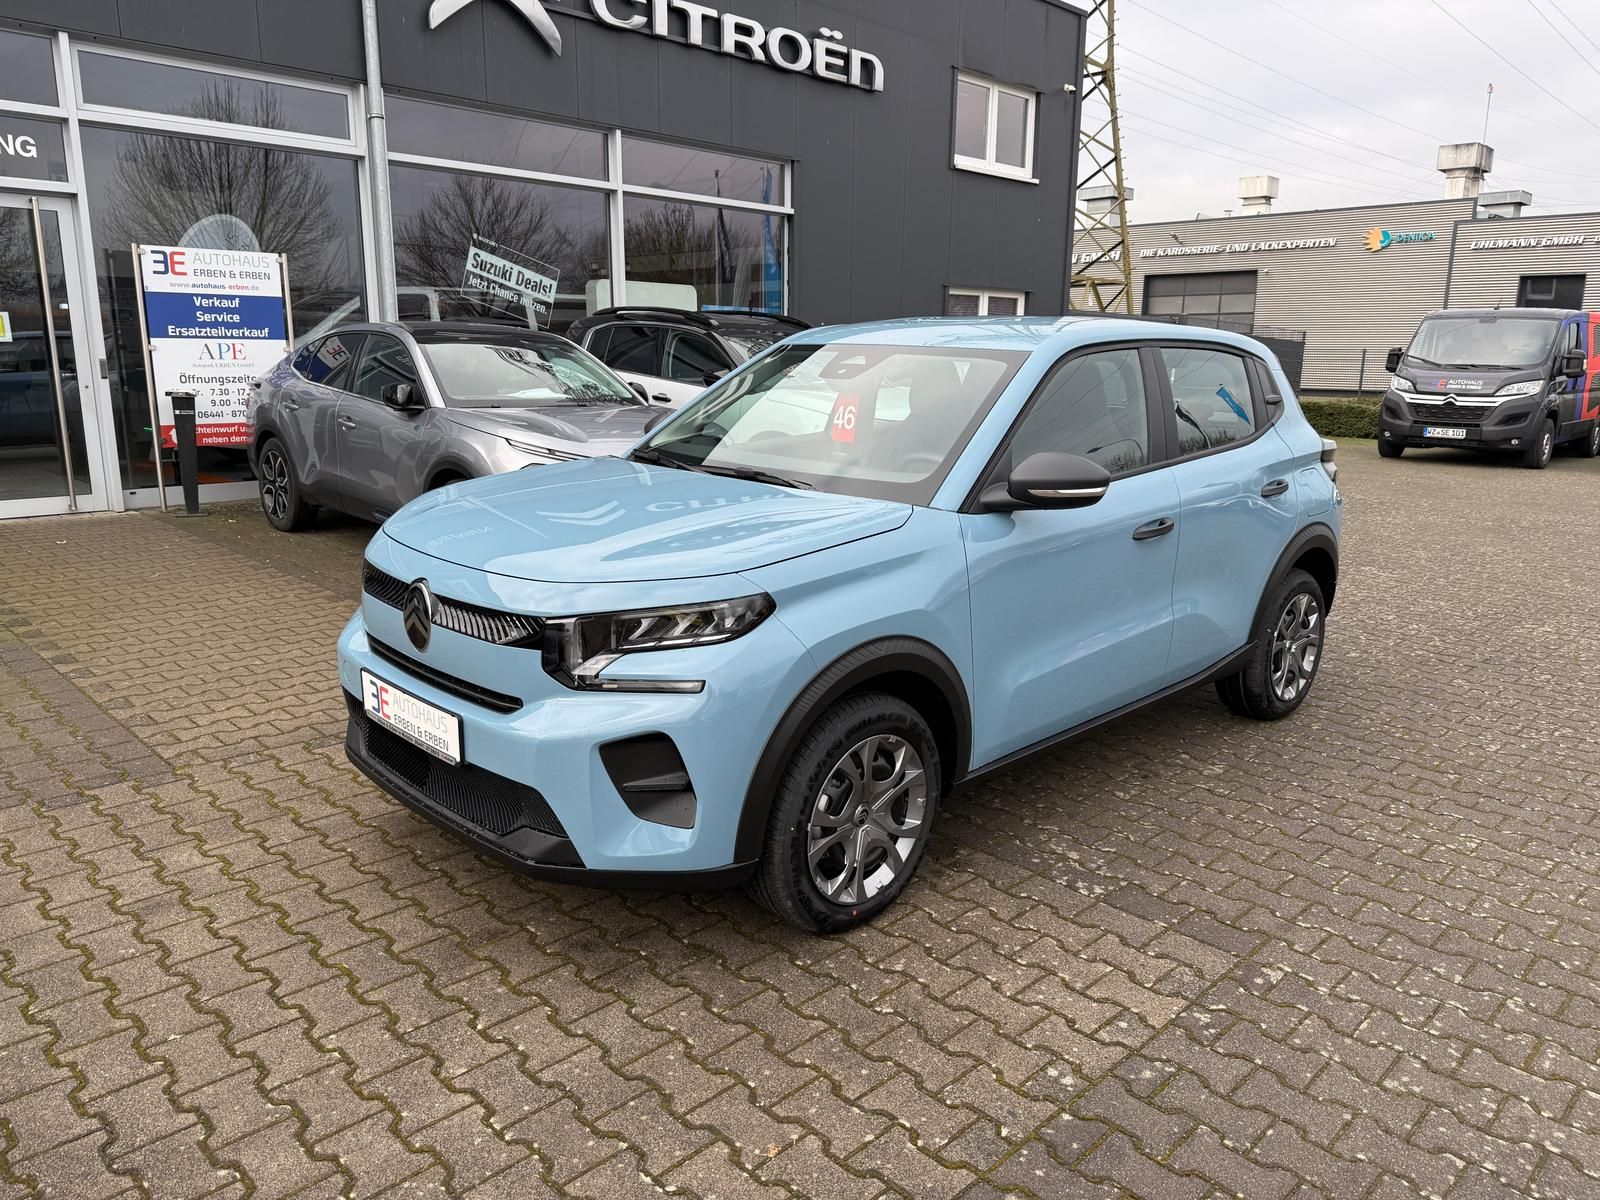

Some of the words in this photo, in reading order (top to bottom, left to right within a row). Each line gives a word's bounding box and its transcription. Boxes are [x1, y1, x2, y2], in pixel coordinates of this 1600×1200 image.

[1140, 248, 1156, 258] DIE
[1226, 242, 1249, 254] UND
[1250, 238, 1337, 251] LACKEXPERTEN
[1470, 238, 1538, 250] UHLMANN
[1542, 236, 1585, 248] GMBH
[192, 252, 270, 268] AUTOHAUS
[194, 268, 226, 278] ERBEN
[229, 270, 236, 279] &
[240, 270, 270, 280] ERBEN
[471, 252, 514, 282] Suzuki
[516, 270, 552, 298] Deals!
[170, 282, 260, 291] www.autohaus-erben.de
[193, 296, 240, 308] Verkauf
[468, 274, 489, 290] Jetzt
[490, 282, 518, 302] Chance
[520, 296, 548, 315] nutzen.
[196, 311, 240, 322] Service
[168, 325, 270, 338] Ersatzteilverkauf
[199, 342, 246, 360] APE
[210, 388, 230, 396] 7.30
[197, 410, 224, 418] 06441
[834, 406, 856, 430] 46
[393, 693, 448, 734] AUTOHAUS
[394, 714, 416, 734] ERBEN
[417, 726, 424, 739] &
[424, 730, 449, 752] ERBEN
